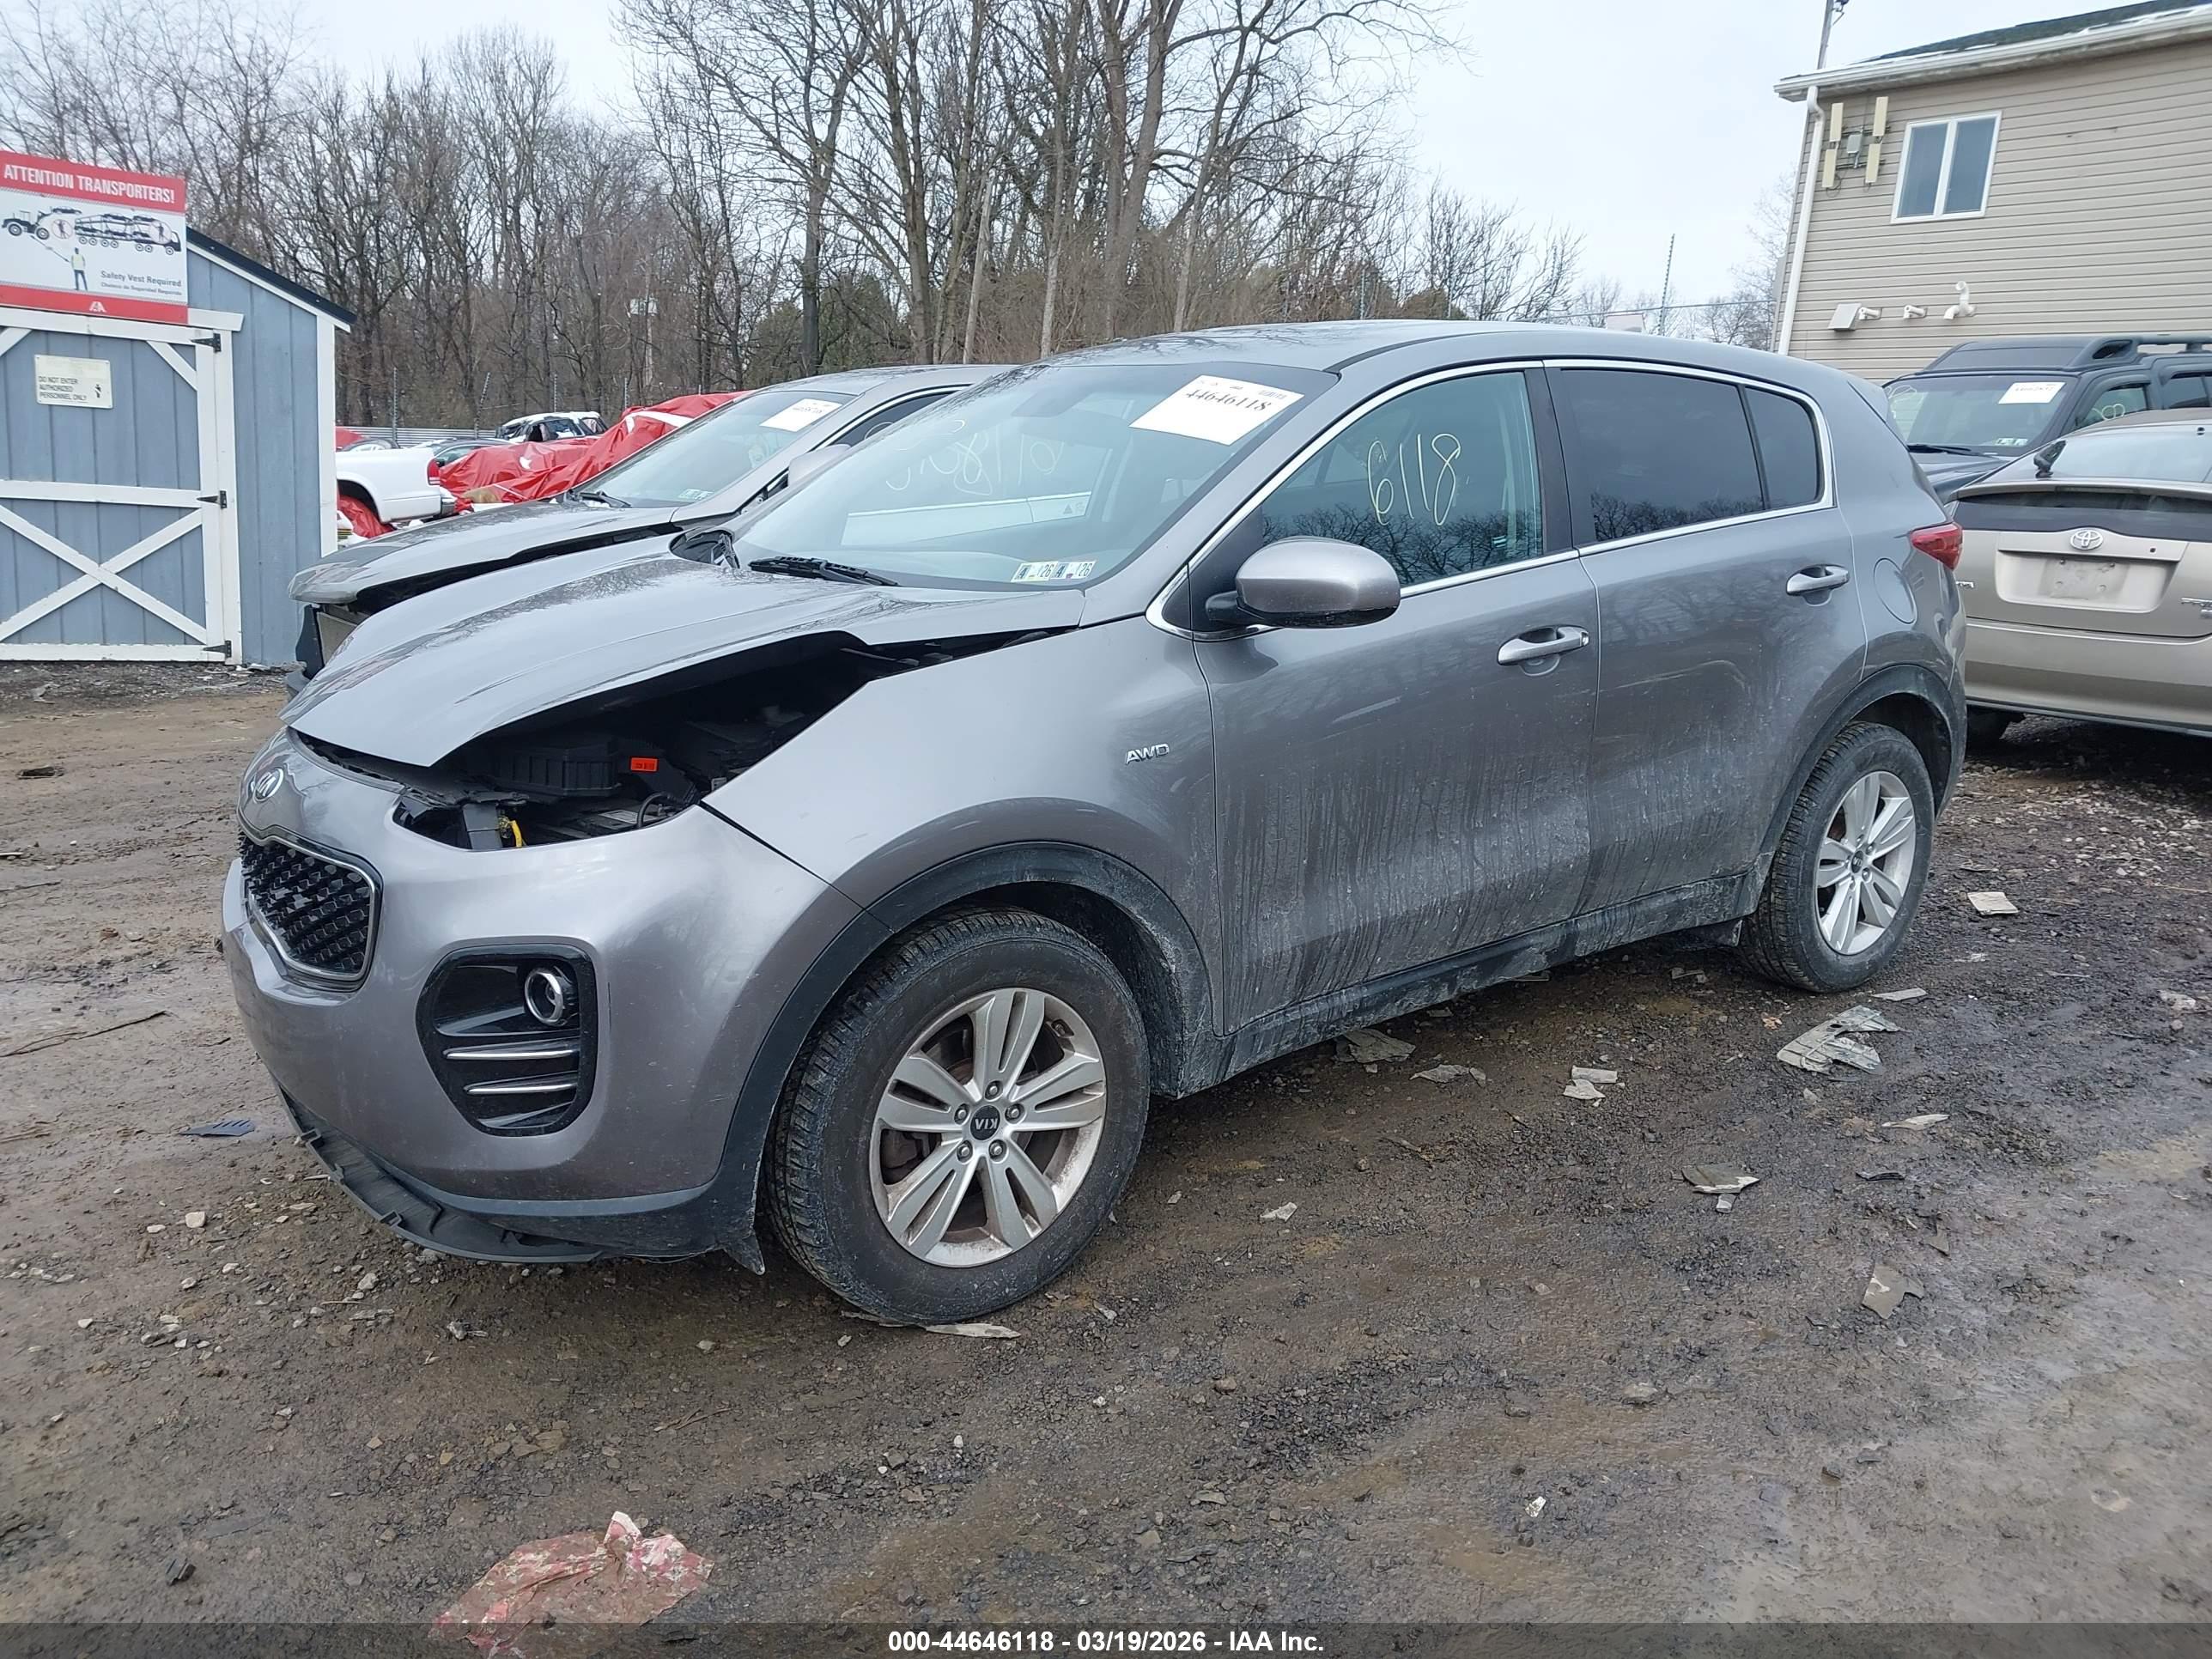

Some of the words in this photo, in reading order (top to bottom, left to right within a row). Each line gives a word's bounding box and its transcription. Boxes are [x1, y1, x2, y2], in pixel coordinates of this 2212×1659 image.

[3, 164, 74, 189] ATTENTION
[77, 175, 175, 204] TRANSPORTERS!
[100, 270, 125, 282] Safety
[127, 274, 144, 283] Vest
[147, 276, 181, 288] Required
[1185, 388, 1272, 411] 44646118
[1367, 433, 1462, 526] 6118
[1125, 743, 1170, 765] AWD
[975, 1118, 999, 1130] KIA
